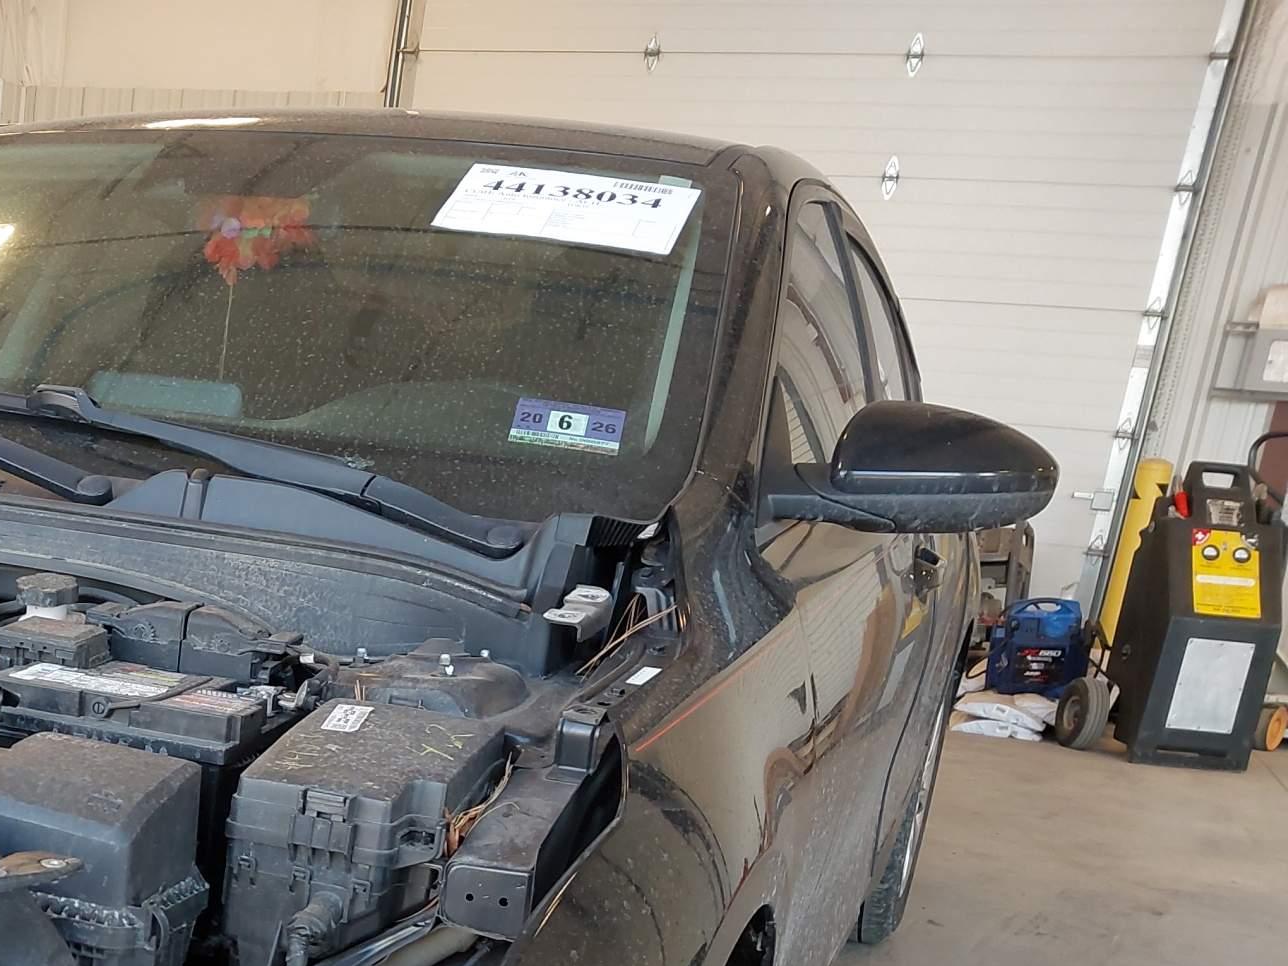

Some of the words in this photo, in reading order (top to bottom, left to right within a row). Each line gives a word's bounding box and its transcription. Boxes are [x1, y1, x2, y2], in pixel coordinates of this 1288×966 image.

[483, 179, 662, 209] 44138034
[519, 411, 544, 424] 20
[558, 414, 573, 431] 6
[591, 421, 617, 434] 26
